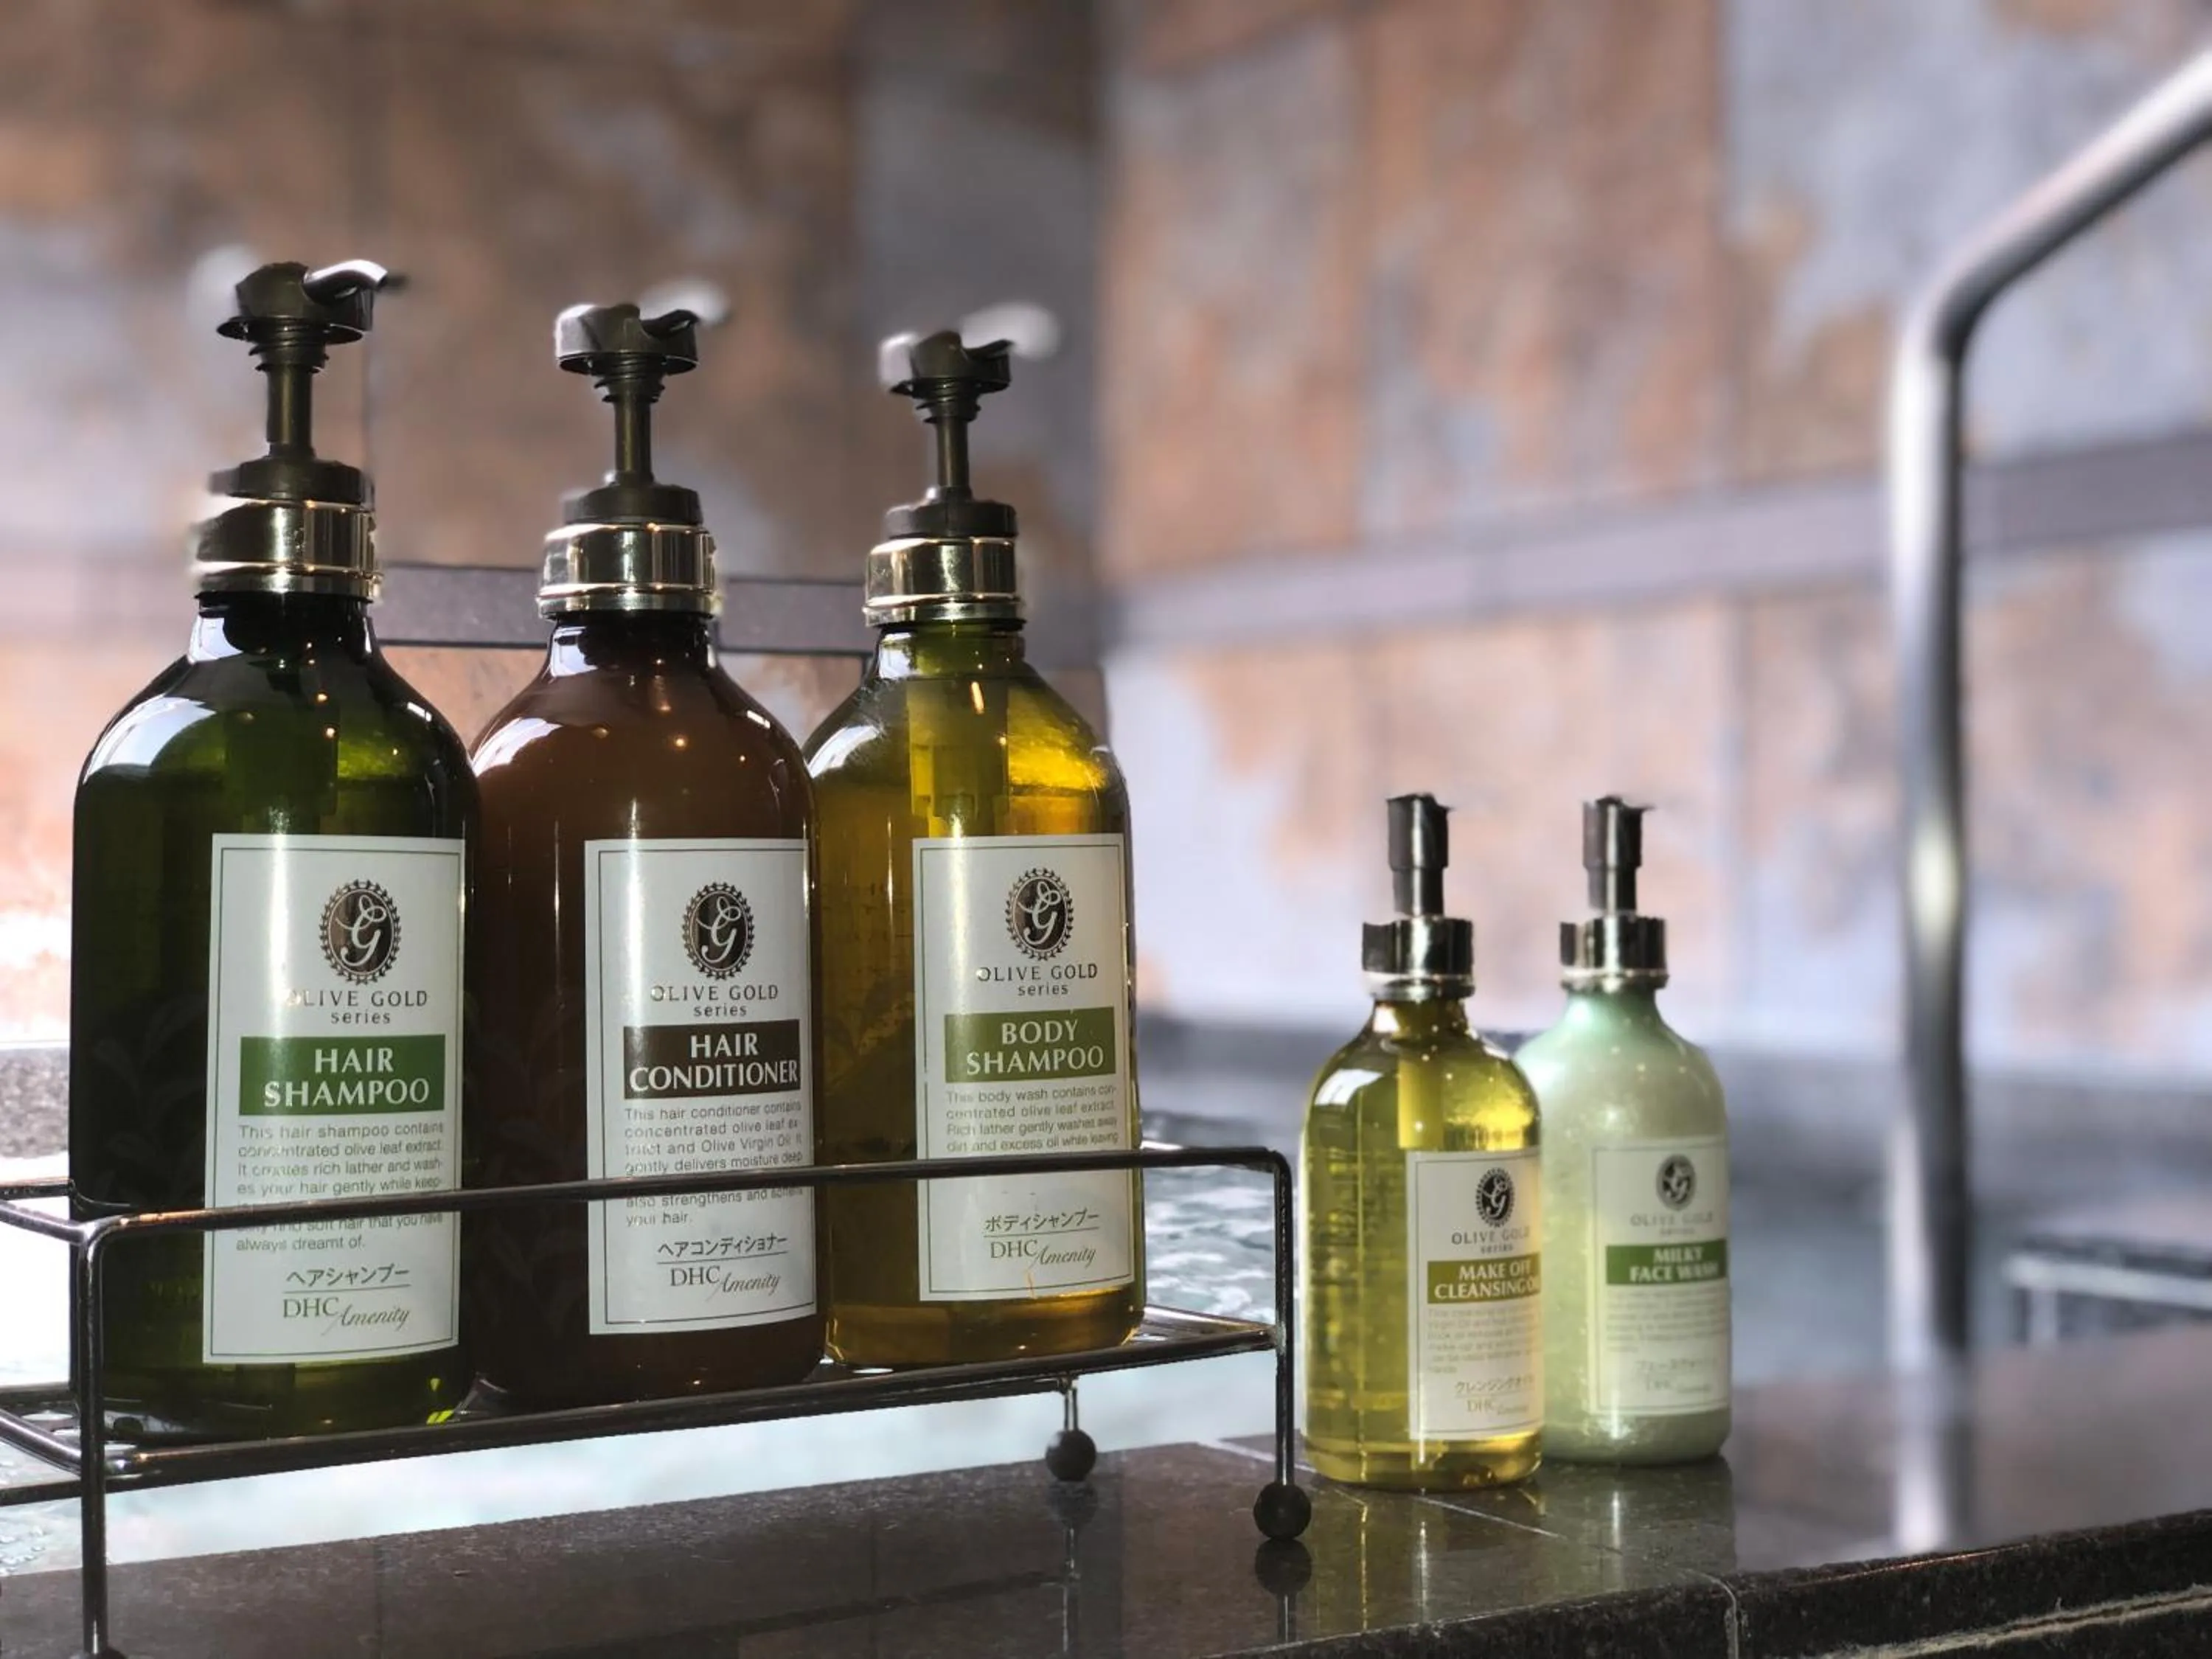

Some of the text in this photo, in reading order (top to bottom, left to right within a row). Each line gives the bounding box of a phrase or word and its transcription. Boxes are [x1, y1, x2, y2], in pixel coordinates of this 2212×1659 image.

[976, 963, 1098, 982] OLIVE GOLD
[650, 984, 779, 1002] OLIVE GOLD
[1018, 981, 1068, 996] series
[371, 990, 428, 1007] GOLD
[331, 1010, 391, 1024] series
[693, 1002, 748, 1018] series
[1002, 1019, 1079, 1045] BODY
[690, 1032, 759, 1059] HAIR
[315, 1048, 394, 1074] HAIR
[967, 1046, 1104, 1076] SHAMPOO
[629, 1060, 799, 1092] CONDITIONER
[264, 1078, 430, 1107] SHAMPOO
[978, 1090, 1011, 1104] body
[1015, 1087, 1048, 1101] wash
[660, 1107, 686, 1120] hair
[691, 1103, 760, 1119] conditioner
[1021, 1104, 1051, 1118] olive
[238, 1124, 274, 1139] This
[280, 1124, 311, 1138] hair
[318, 1124, 389, 1139] shampoo
[625, 1120, 727, 1138] concentrated
[732, 1120, 762, 1135] olive
[947, 1123, 976, 1136] Rich
[980, 1122, 1015, 1135] lather
[1018, 1119, 1054, 1136] gently
[344, 1143, 376, 1156] olive
[380, 1140, 402, 1155] leaf
[667, 1141, 696, 1155] and
[701, 1138, 735, 1152] Olive
[740, 1136, 774, 1152] Virgin
[1001, 1138, 1043, 1151] excess
[313, 1161, 341, 1175] rich
[345, 1160, 383, 1175] lather
[387, 1158, 411, 1173] and
[674, 1158, 726, 1172] delivers
[237, 1183, 256, 1194] es
[299, 1180, 328, 1194] hair
[333, 1179, 375, 1196] gently
[380, 1178, 412, 1192] while
[746, 1188, 767, 1202] and
[985, 1208, 1100, 1232] ボディシャンプー
[237, 1237, 288, 1253] always
[657, 1232, 789, 1257] ヘアコンディショナー
[1451, 1231, 1497, 1245] OLIVE
[991, 1239, 1097, 1270] DHC Amenity
[285, 1262, 411, 1287] ヘアシャンプー
[1458, 1262, 1506, 1281] MAKE
[670, 1265, 782, 1303] DHC Amenity
[283, 1296, 411, 1336] DHC Amenity
